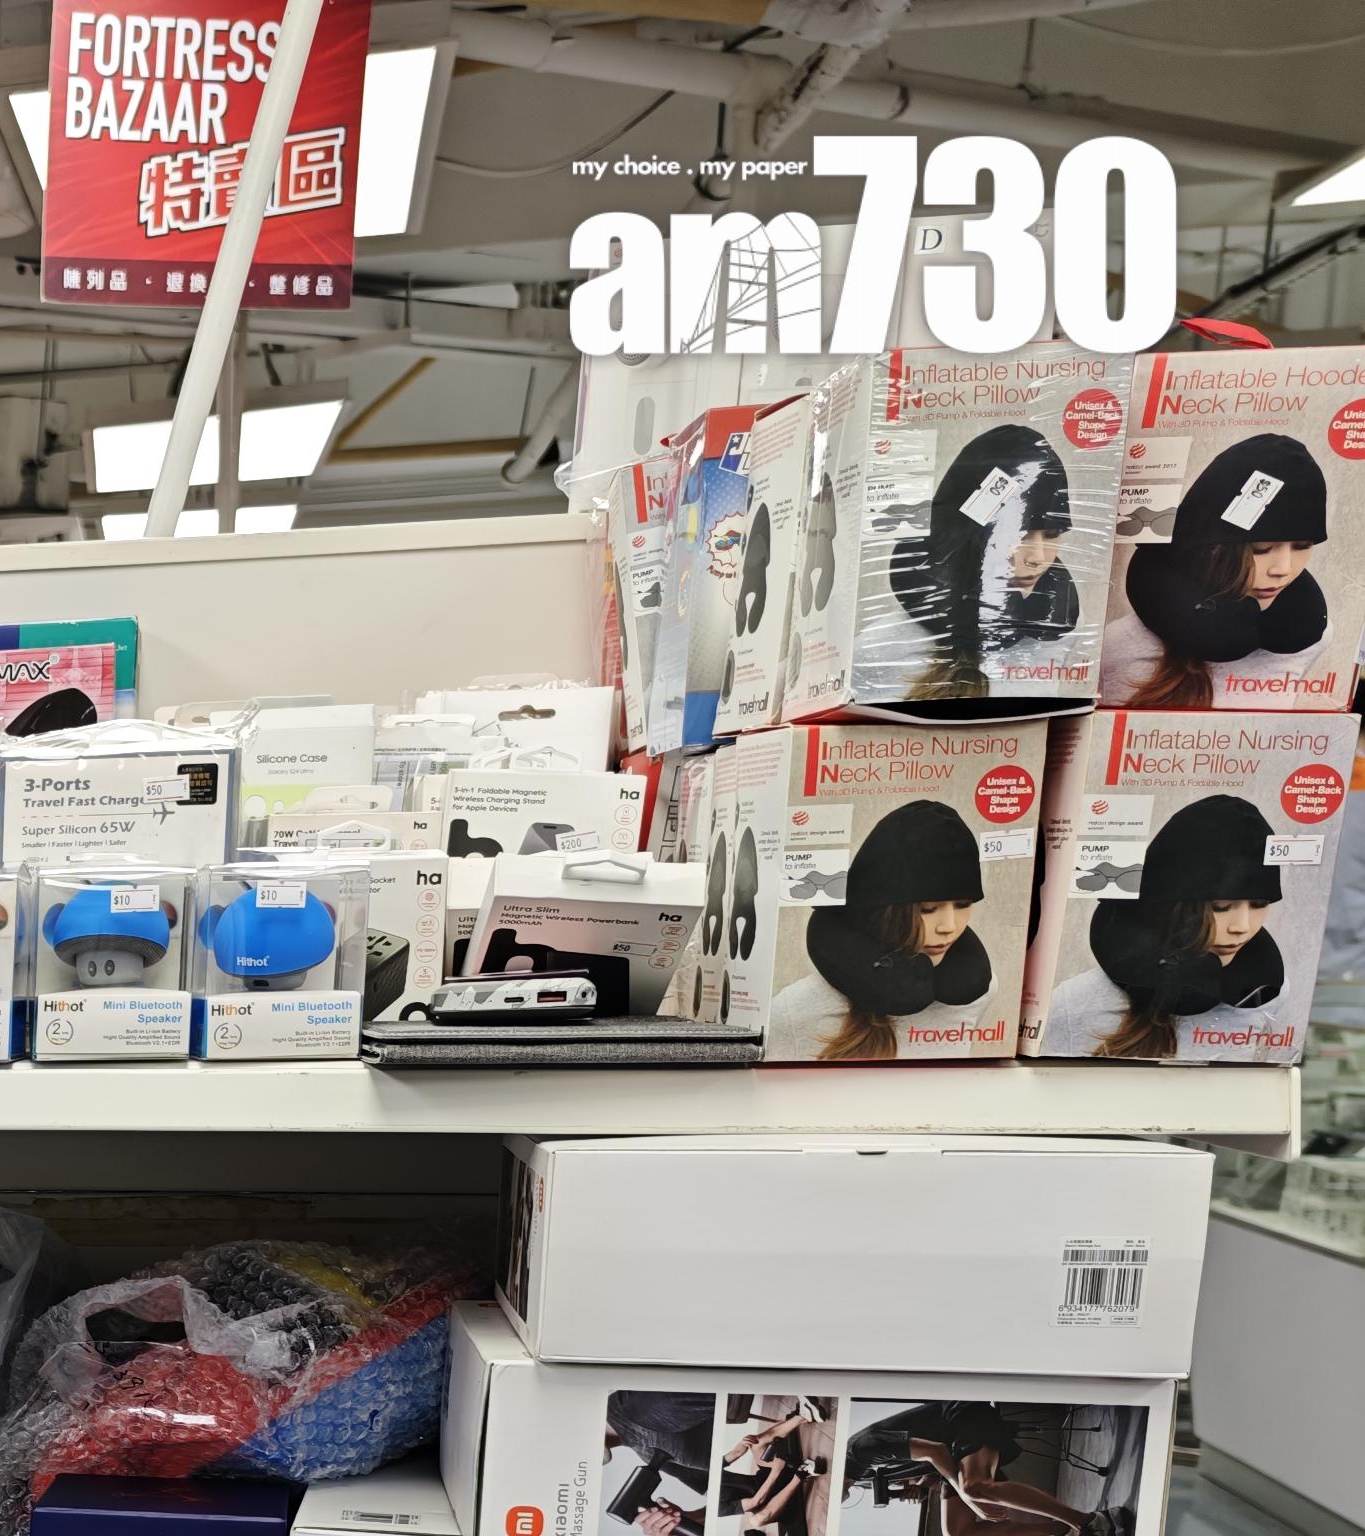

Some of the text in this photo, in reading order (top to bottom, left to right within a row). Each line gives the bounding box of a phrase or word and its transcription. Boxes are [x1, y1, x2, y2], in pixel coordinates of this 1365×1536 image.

[69, 12, 282, 83] FORTRESS
[66, 76, 227, 144] BAZAAR
[903, 357, 1107, 385] Inflatable Nursing
[1160, 392, 1309, 415] Neck Pillow
[1225, 671, 1337, 694] travelmall
[823, 735, 1019, 761] Inflatable Nursing
[1126, 729, 1330, 756] Inflatable Nursing
[257, 754, 327, 763] Silicone Case
[1123, 753, 1261, 774] Neck Pillow
[820, 761, 954, 784] Neck Pillow
[23, 777, 91, 792] 3-Ports
[146, 784, 163, 796] $50
[1284, 785, 1342, 795] Camel-Back
[620, 788, 640, 800] ha
[1297, 795, 1326, 805] Shape
[989, 804, 1020, 815] Design
[1295, 804, 1328, 815] Design
[21, 821, 136, 837] Super Silicon 65W
[560, 838, 582, 850] $200
[984, 841, 1003, 853] $50
[1269, 844, 1289, 857] $50
[785, 854, 812, 862] PUMP
[416, 870, 442, 885] ha
[113, 894, 131, 906] $10
[260, 890, 278, 901] $10
[658, 912, 683, 922] ha
[236, 956, 268, 968] Hithot
[43, 1000, 83, 1013] Hithot
[103, 1000, 183, 1011] Mini Bluetooth
[211, 1003, 252, 1016] Hithot
[271, 1001, 353, 1012] Mini Bluetooth
[137, 1014, 183, 1025] Speaker
[307, 1014, 352, 1025] Speaker
[908, 1021, 1005, 1041] travelmall
[1192, 1026, 1294, 1047] travelmall
[573, 1460, 588, 1485] Gun
